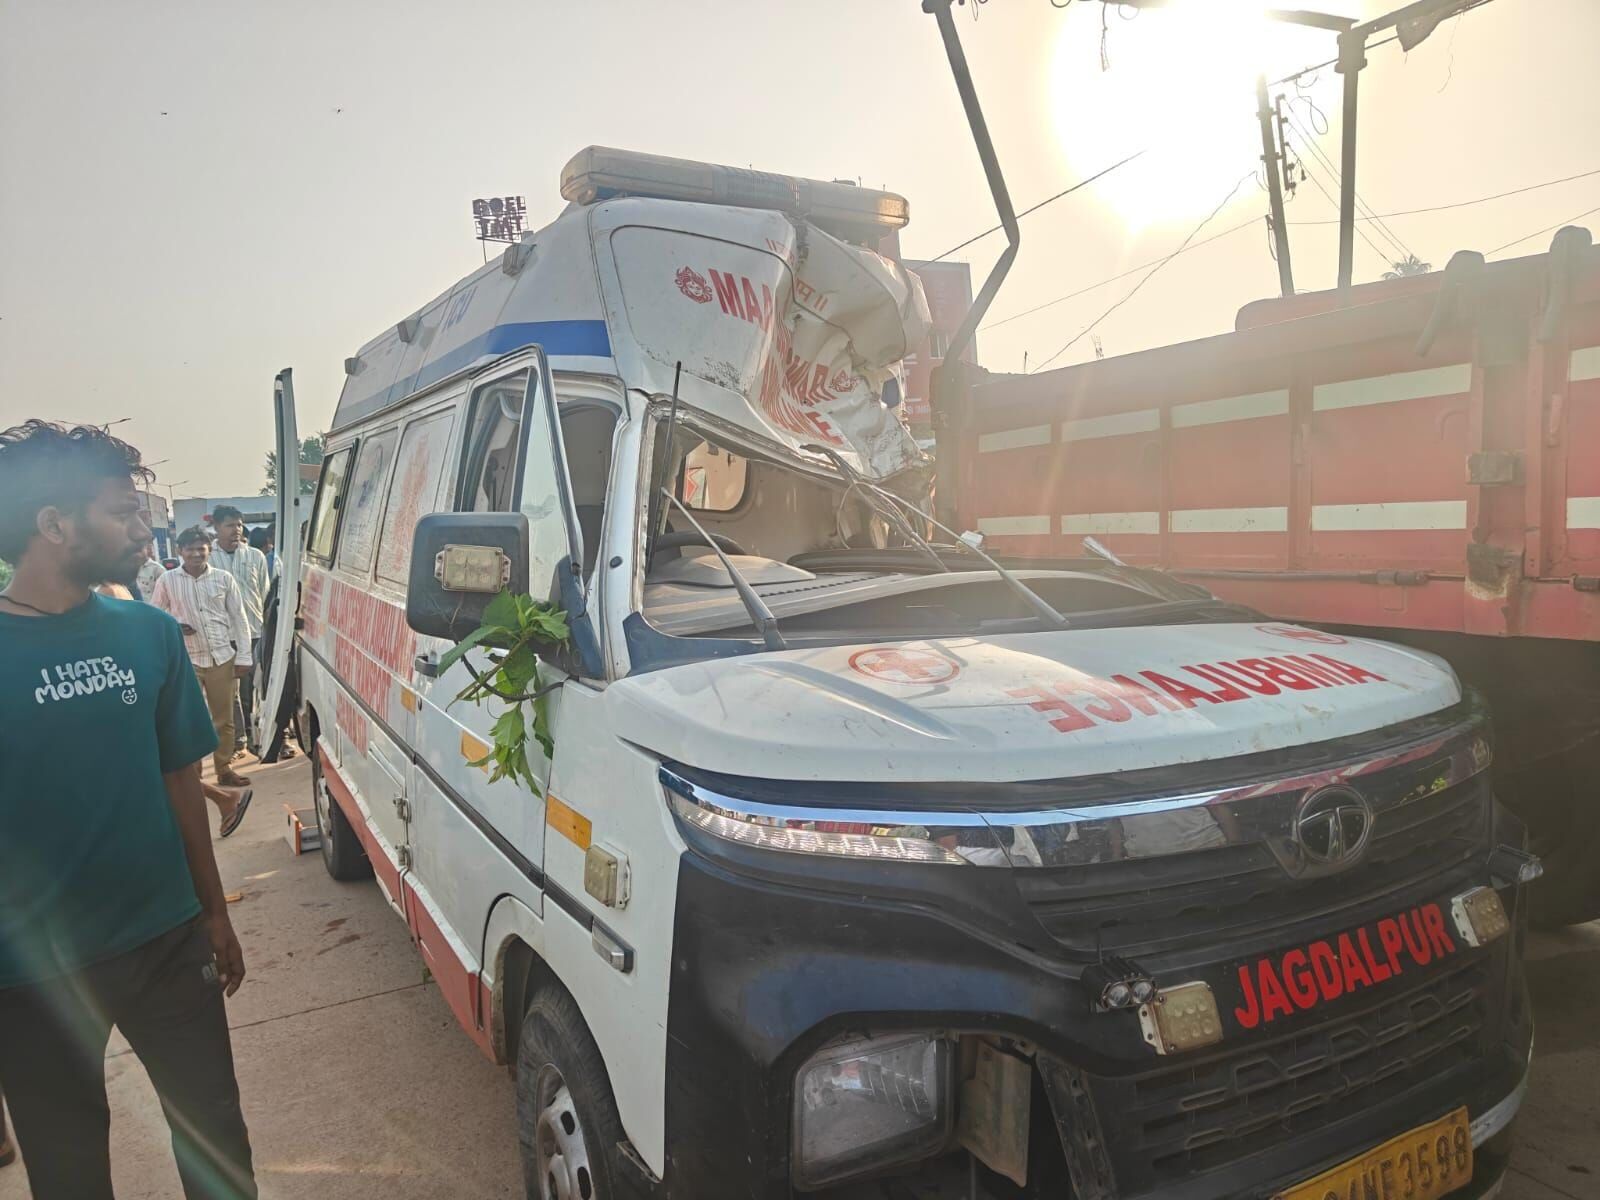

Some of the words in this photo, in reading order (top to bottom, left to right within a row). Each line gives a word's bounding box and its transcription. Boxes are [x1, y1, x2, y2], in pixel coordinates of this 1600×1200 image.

[35, 669, 136, 704] MONDAY
[41, 668, 51, 684] I
[56, 656, 118, 681] HATE
[1235, 903, 1455, 1028] JAGDALPUR
